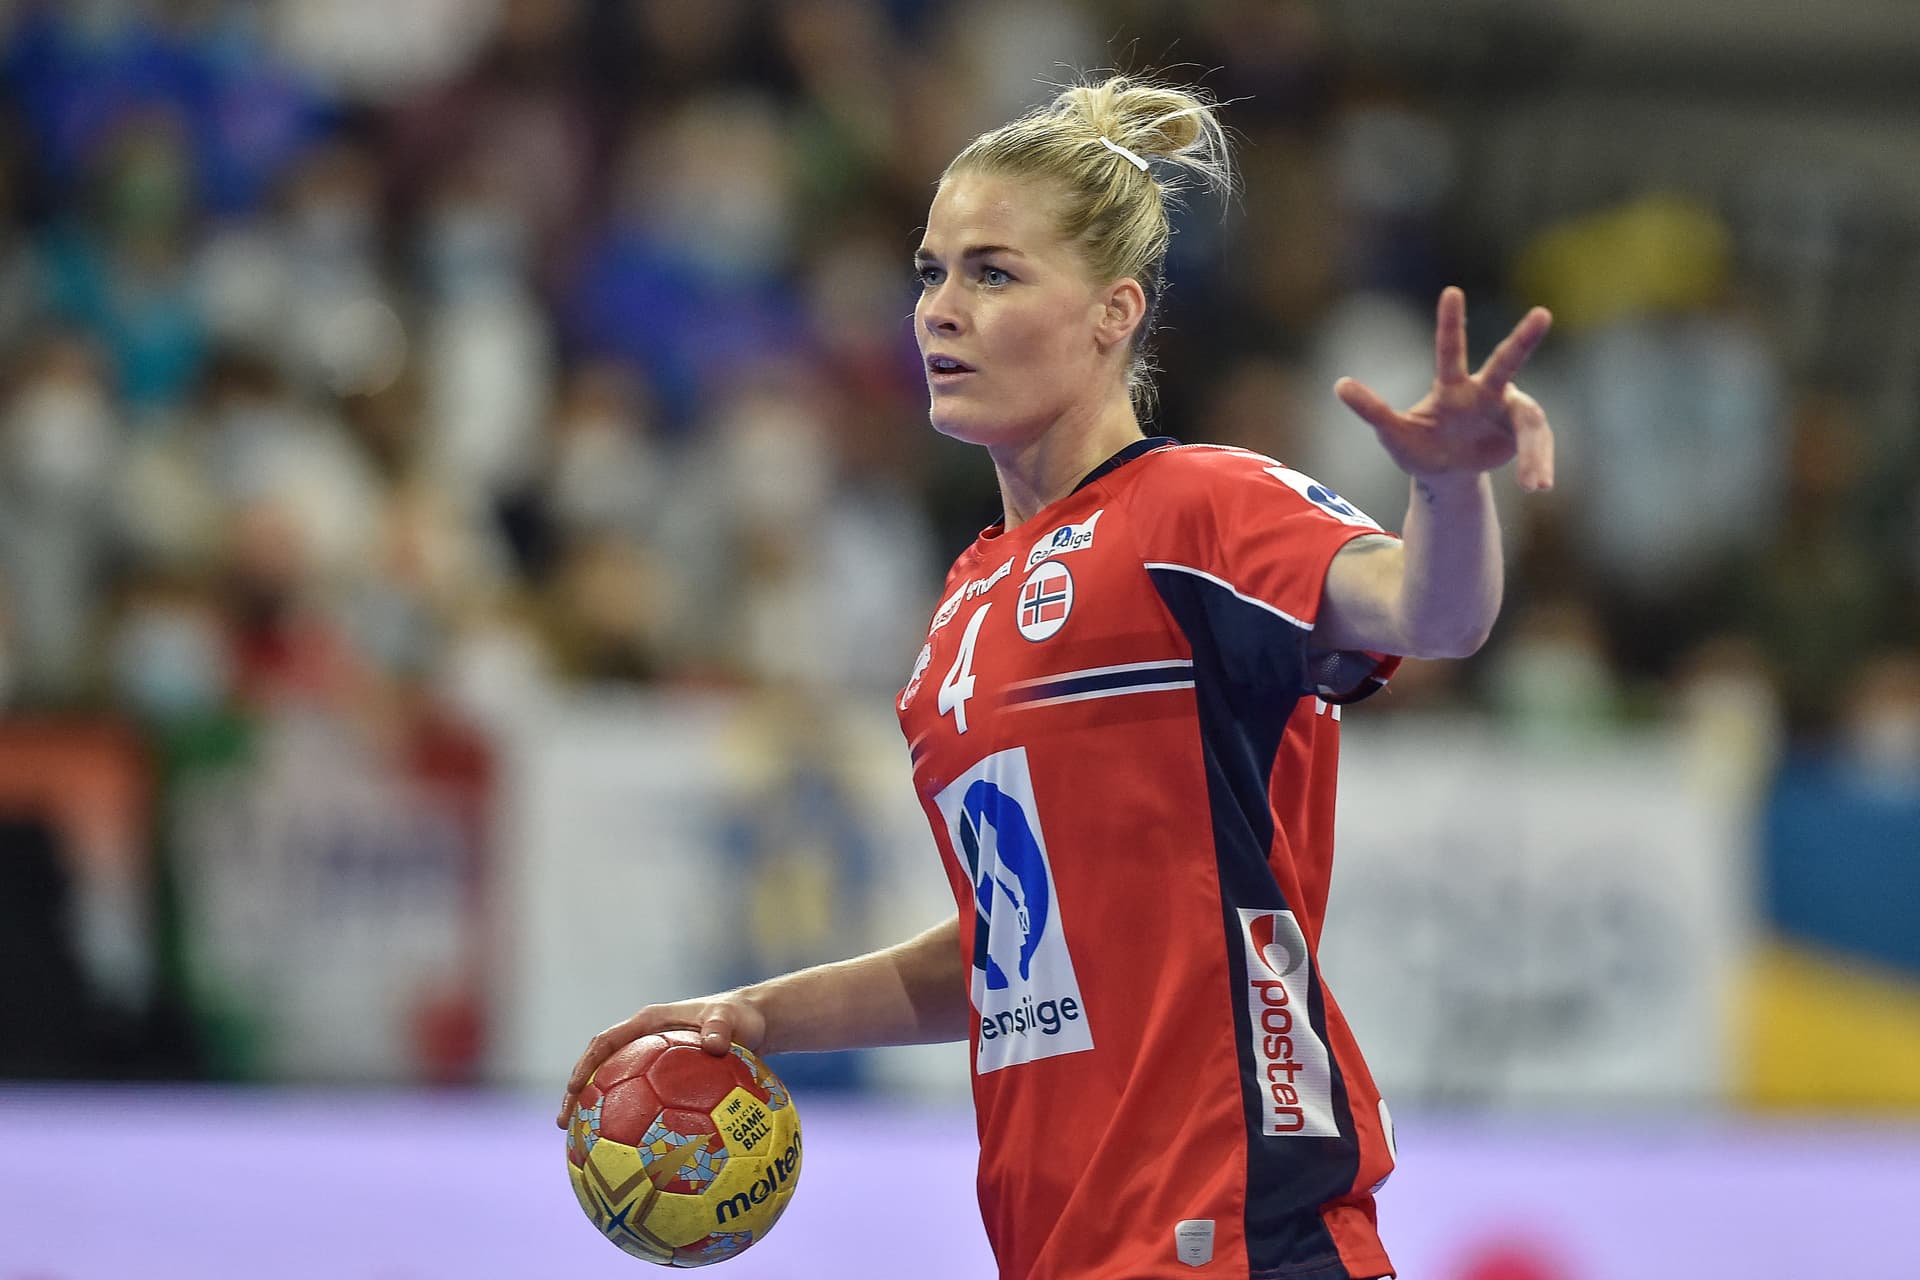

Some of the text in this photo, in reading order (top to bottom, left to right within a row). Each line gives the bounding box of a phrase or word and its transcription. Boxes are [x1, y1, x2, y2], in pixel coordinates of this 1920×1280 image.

[938, 603, 992, 734] 4
[1251, 980, 1304, 1132] posten
[727, 1099, 742, 1115] IHF
[733, 1107, 765, 1141] GAME
[743, 1122, 771, 1151] BALL
[716, 1130, 802, 1224] molten
